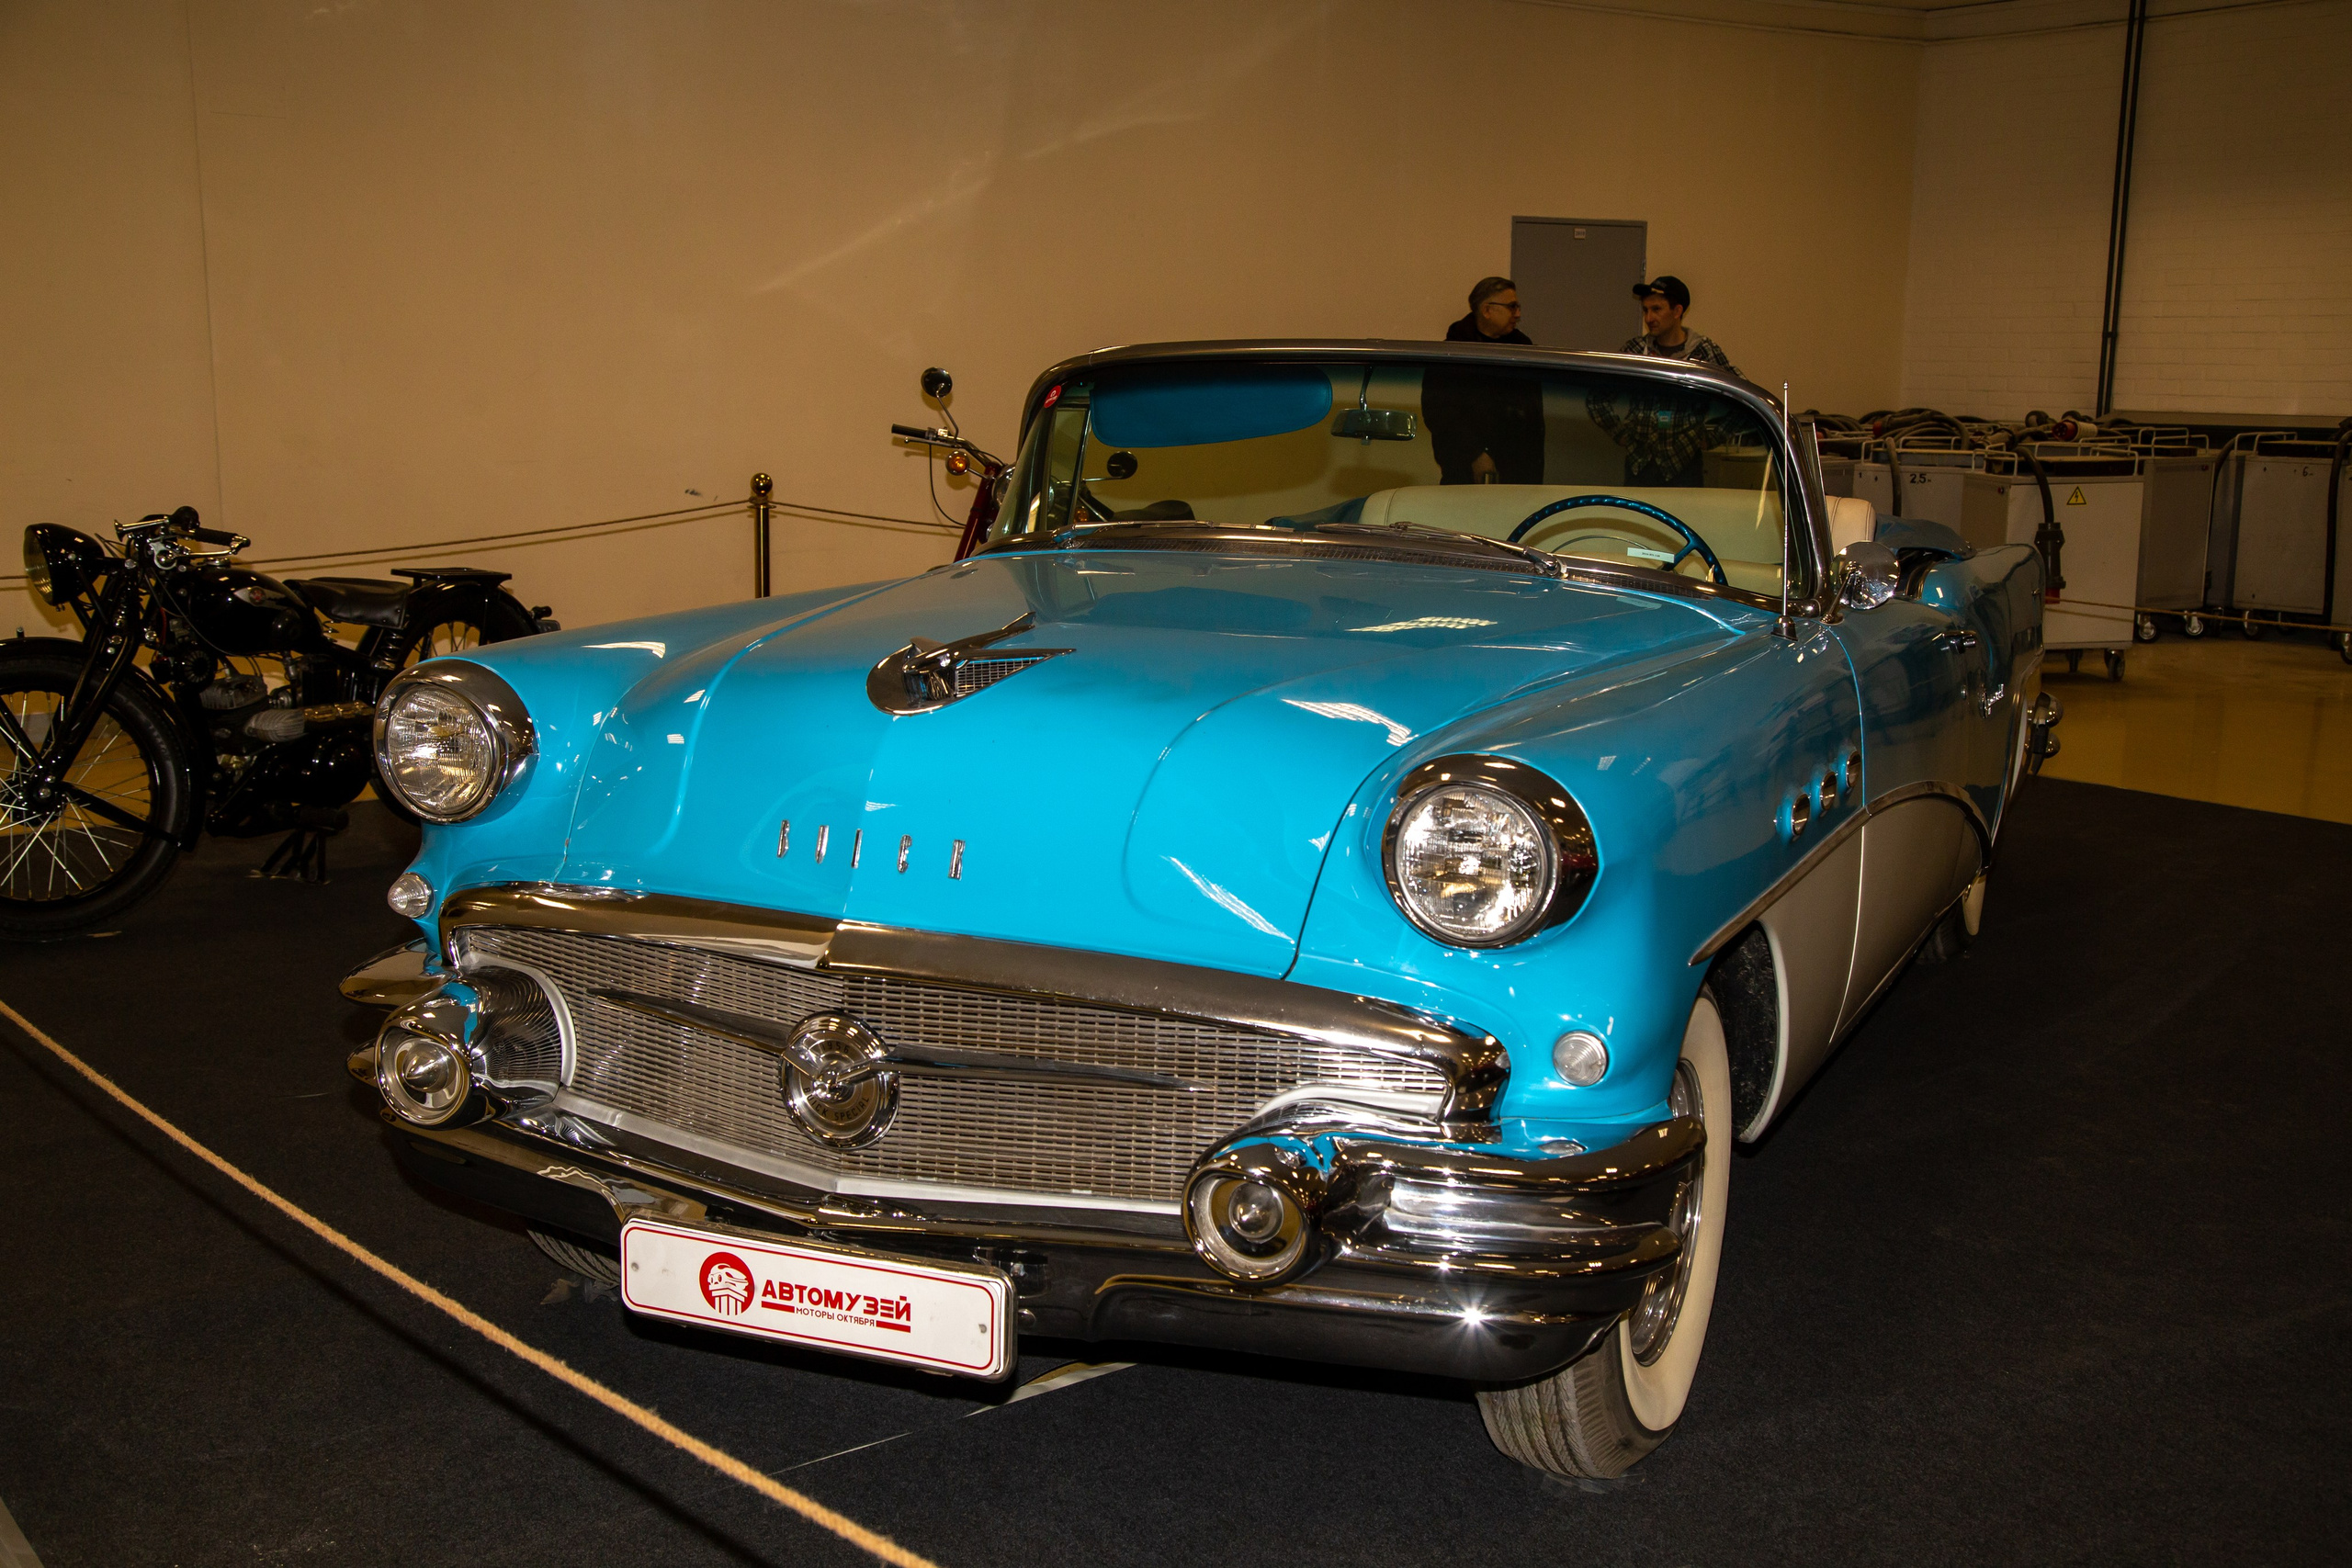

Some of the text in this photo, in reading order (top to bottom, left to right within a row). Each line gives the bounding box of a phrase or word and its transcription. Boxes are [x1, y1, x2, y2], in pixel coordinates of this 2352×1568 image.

[822, 1041, 849, 1054] 1956
[803, 1088, 869, 1121] BUICK SPECIAL
[762, 1280, 911, 1322] АВТОМУЗЕЙ
[796, 1307, 875, 1327] МОТОРЫ ОКТЯБРЯ
